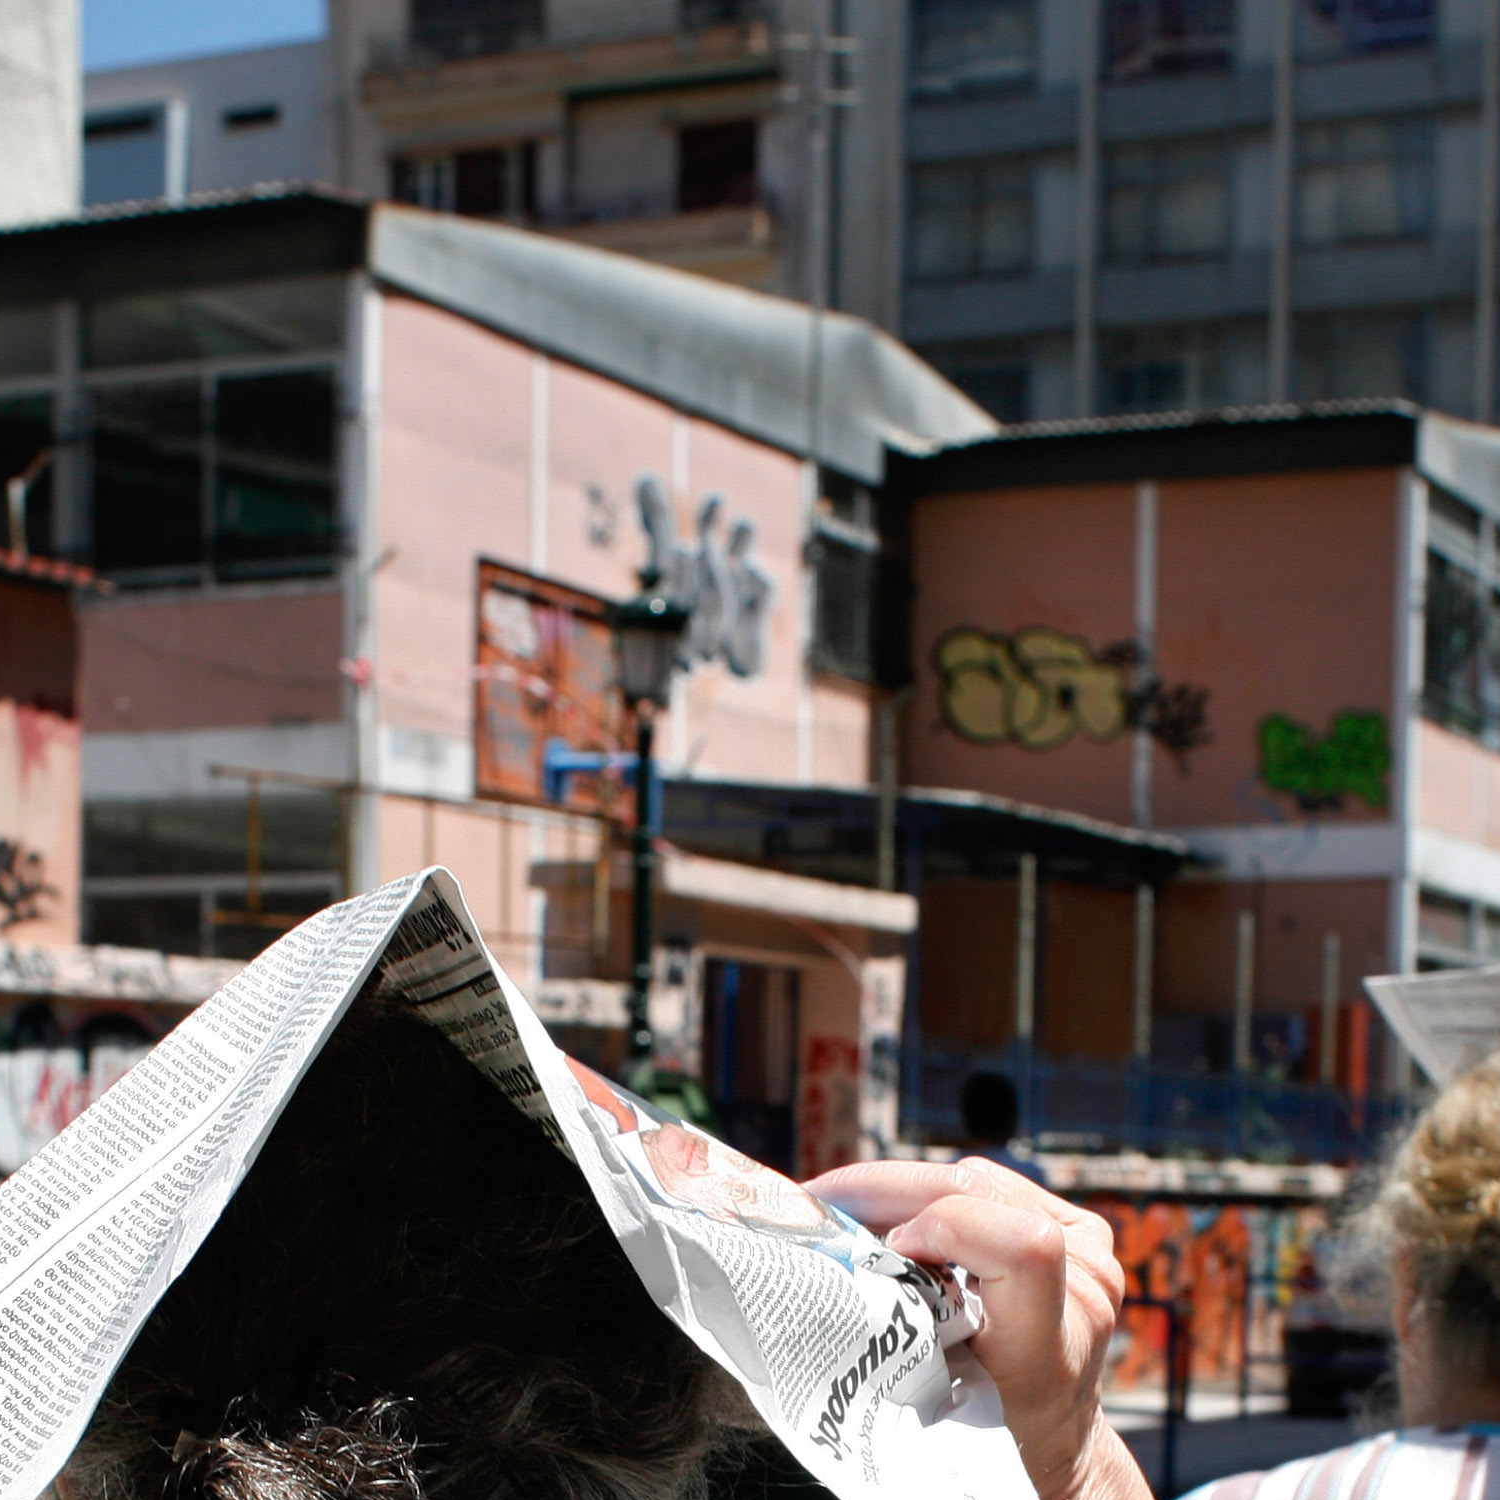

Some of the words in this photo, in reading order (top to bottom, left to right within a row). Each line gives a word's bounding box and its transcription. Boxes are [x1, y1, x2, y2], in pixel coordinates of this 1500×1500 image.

[29, 1312, 47, 1327] και
[48, 1307, 67, 1324] του
[808, 1298, 919, 1461] Σαμαράς
[884, 1338, 931, 1395] επαφή
[4, 1382, 25, 1400] που
[20, 1395, 36, 1412] θα
[869, 1381, 885, 1412] με
